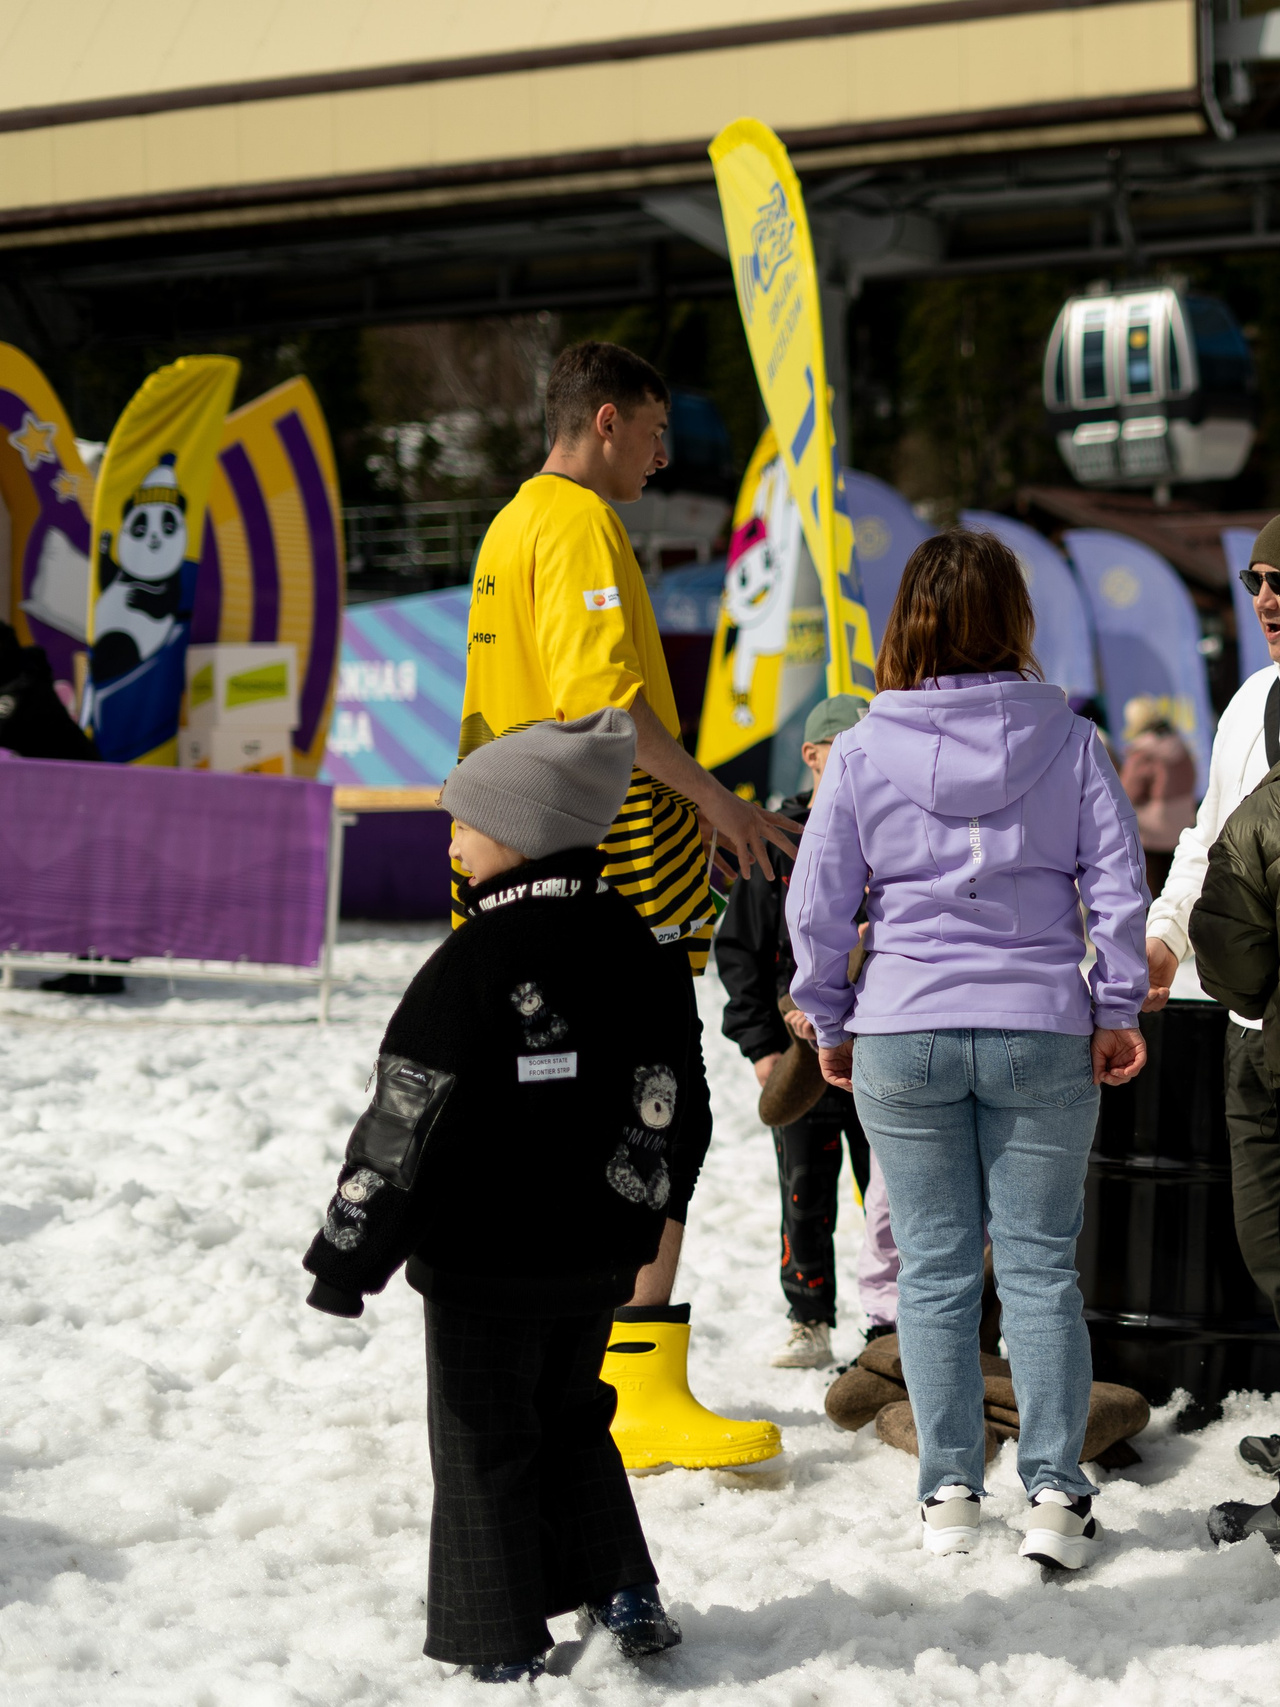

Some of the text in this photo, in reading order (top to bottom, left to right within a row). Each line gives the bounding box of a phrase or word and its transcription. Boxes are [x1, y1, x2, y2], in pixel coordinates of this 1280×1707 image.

[531, 878, 581, 897] EARLY
[658, 932, 678, 942] 2ГИС
[529, 1068, 556, 1076] FRONTIER
